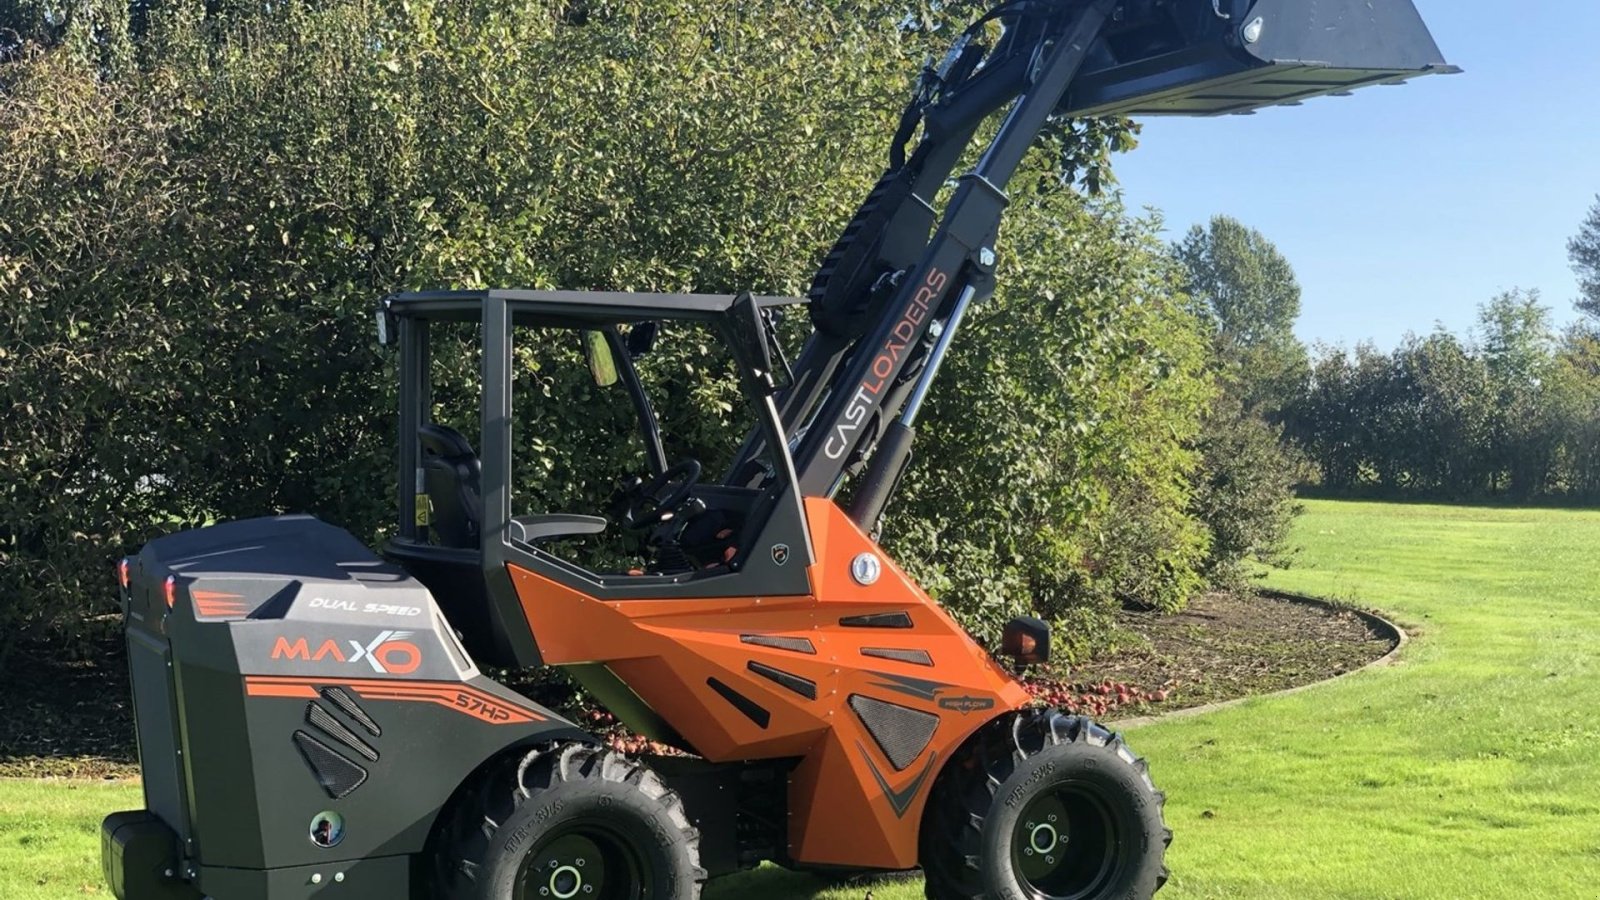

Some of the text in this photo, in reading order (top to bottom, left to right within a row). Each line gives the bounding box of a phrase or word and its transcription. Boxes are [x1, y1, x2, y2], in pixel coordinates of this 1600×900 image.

[308, 597, 422, 617] DUAL SPEED
[271, 630, 422, 675] MAXO
[455, 693, 510, 720] 57HP
